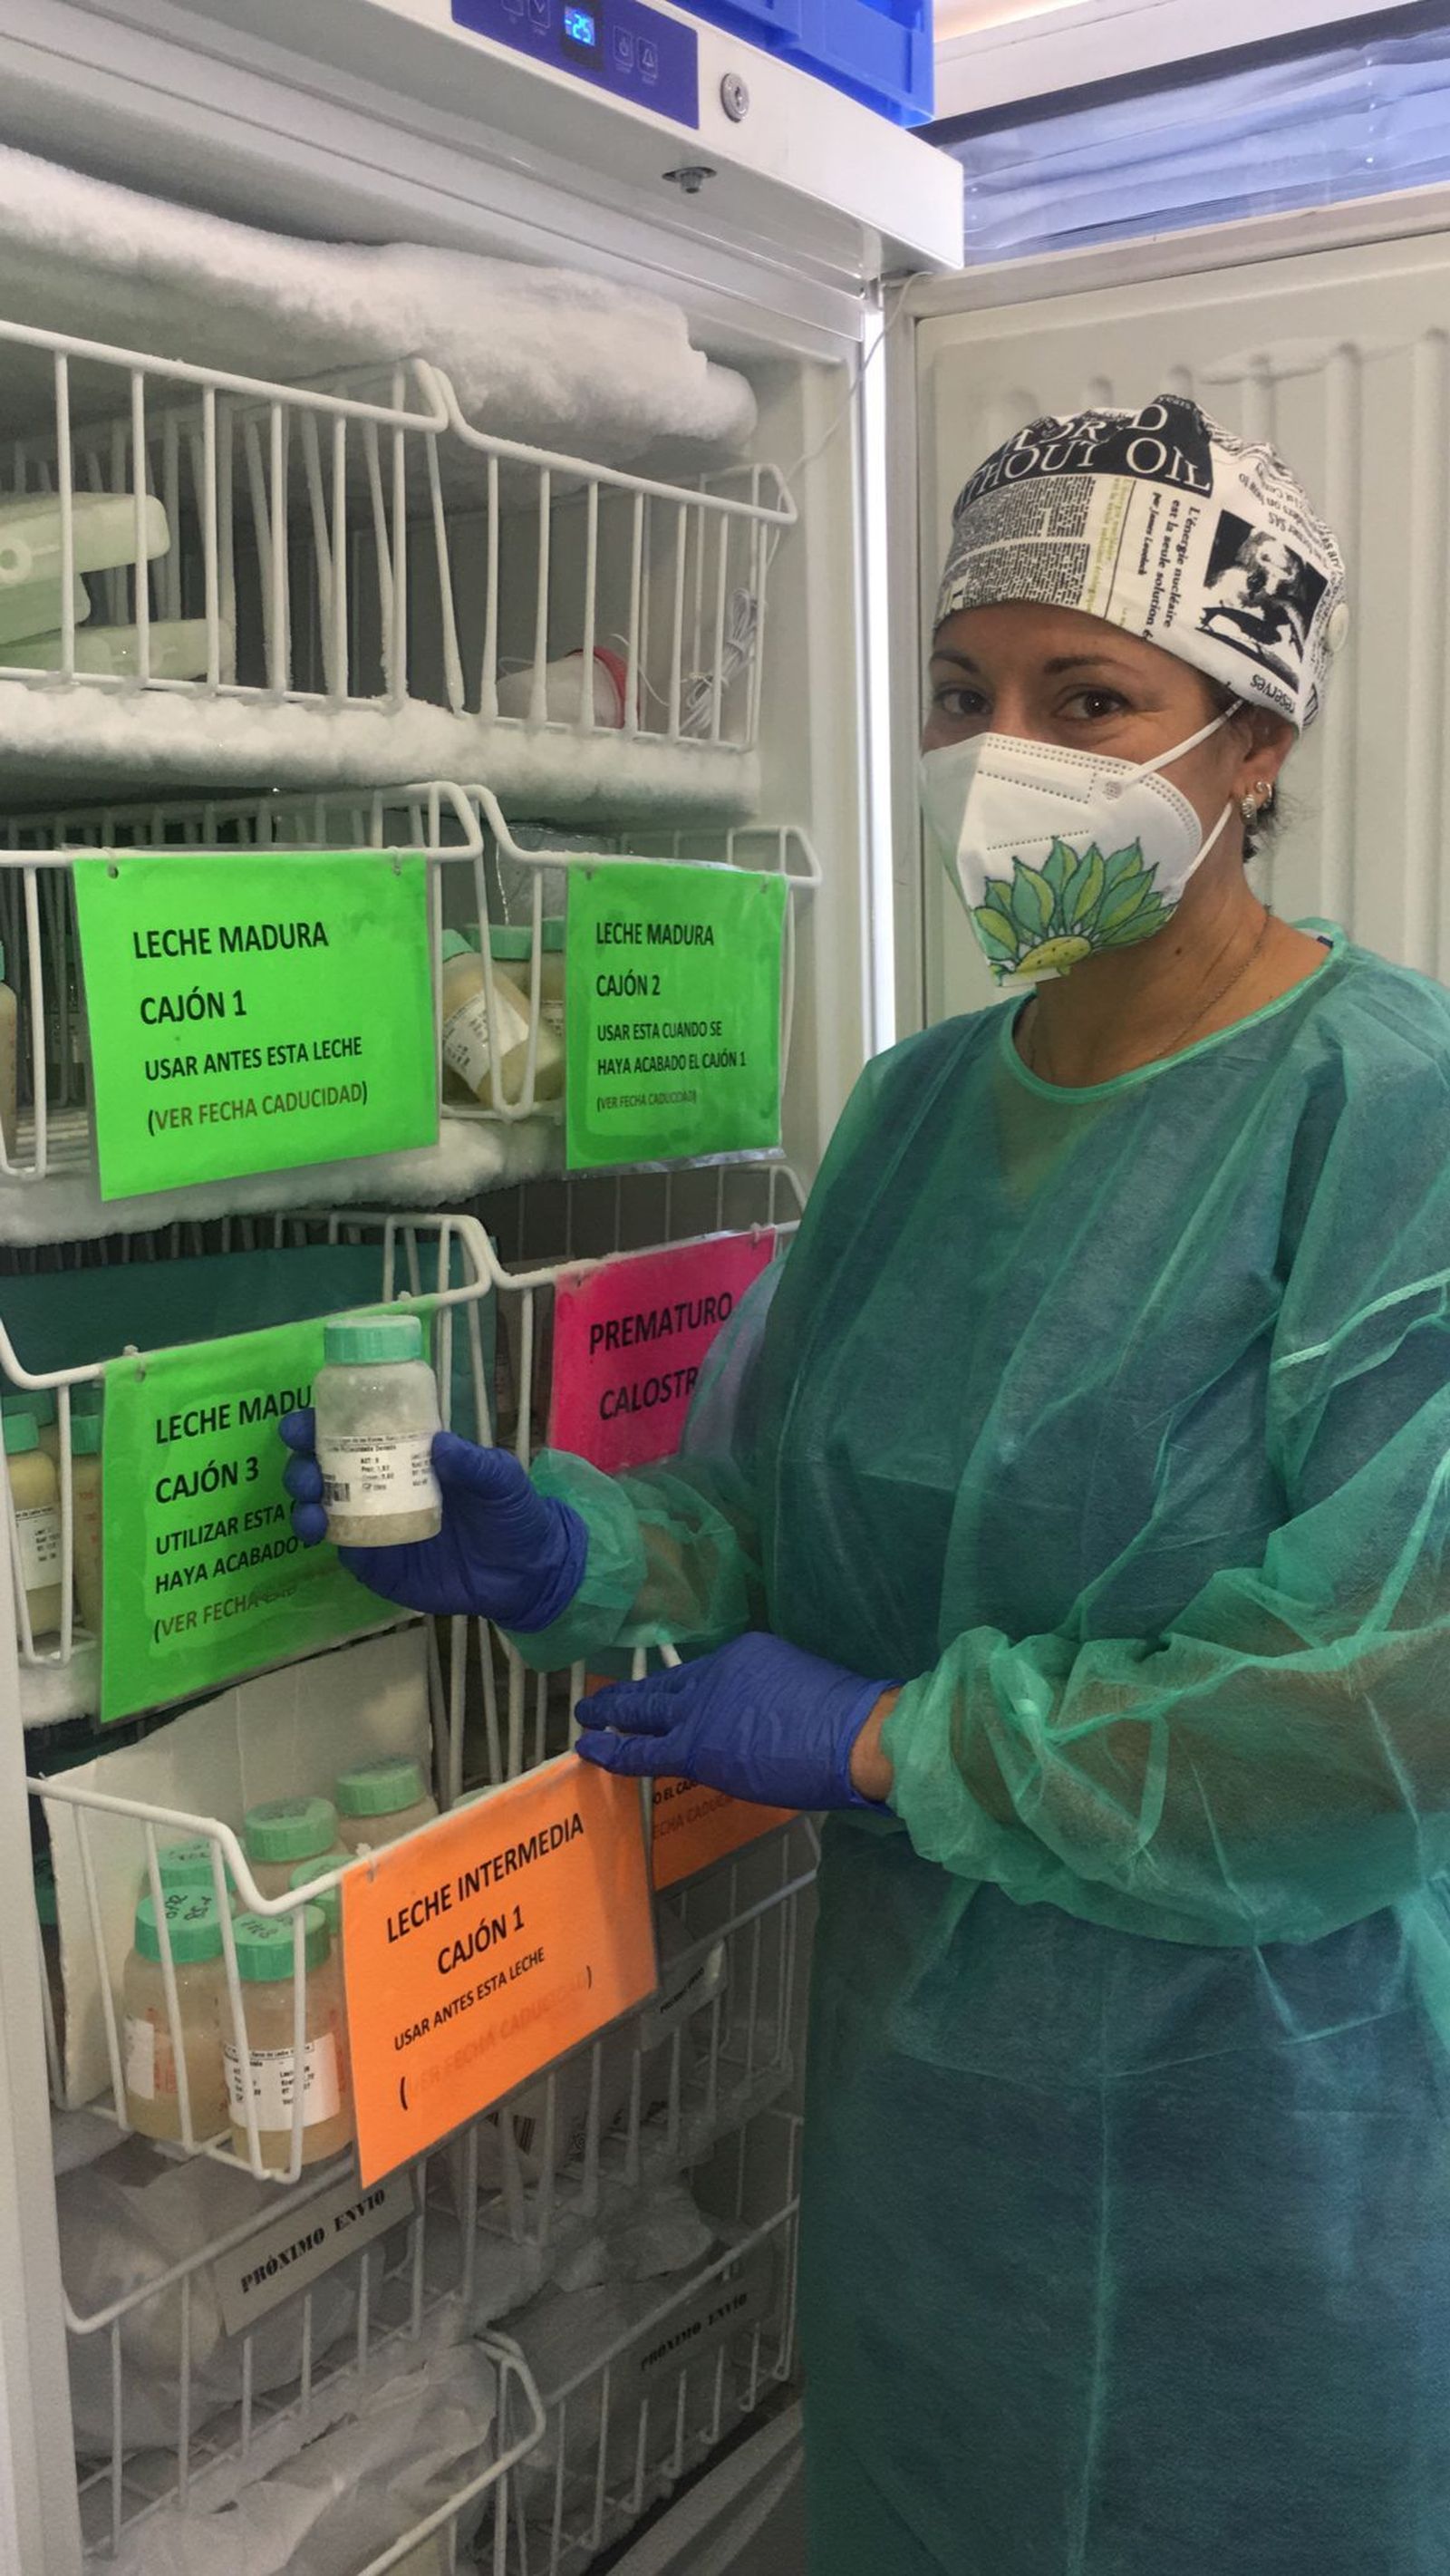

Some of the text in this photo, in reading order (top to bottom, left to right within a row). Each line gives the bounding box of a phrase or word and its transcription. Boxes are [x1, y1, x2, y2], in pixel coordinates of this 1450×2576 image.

[1126, 437, 1211, 490] OIL
[1165, 520, 1180, 533] la
[1169, 499, 1181, 519] est
[1158, 535, 1171, 568] seule
[1163, 507, 1201, 628] L'énergie nucléaire
[1146, 572, 1165, 625] solution
[133, 921, 330, 959] LECHE MADURA
[595, 922, 714, 946] LECHE MADURA
[140, 986, 247, 1025] CAJÓN 1
[595, 968, 662, 998] CAJÓN 2
[597, 1021, 723, 1041] USAR ESTA CUANDO SE
[144, 1036, 363, 1082] USAR ANTES ESTA LECHE
[597, 1047, 747, 1077] HAYA ACABADO EL CAJÓN 1
[147, 1080, 369, 1138] (VER FECHA CADUCIDAD)
[596, 1094, 618, 1113] (VER
[619, 1093, 648, 1109] FECHA
[589, 1292, 734, 1356] PREMATURO
[156, 1385, 314, 1446] LECHE MADU
[598, 1366, 700, 1422] CALOSTR
[156, 1455, 260, 1505] CAJÓN 3
[156, 1516, 240, 1556] UTILIZAR
[243, 1506, 285, 1533] ESTA
[155, 1559, 208, 1595] HAYA
[212, 1535, 299, 1579] ACABADO
[153, 1612, 198, 1645] (VER
[202, 1593, 257, 1627] FECHA
[652, 1814, 684, 1839] ECHA
[386, 1812, 585, 1944] LECHE INTERMEDIA
[436, 1904, 526, 1976] CAJÓN 1
[393, 1947, 546, 2052] USAR ANTES ESTA LECHE
[239, 2188, 386, 2295] PRÓXIMO ENVIO
